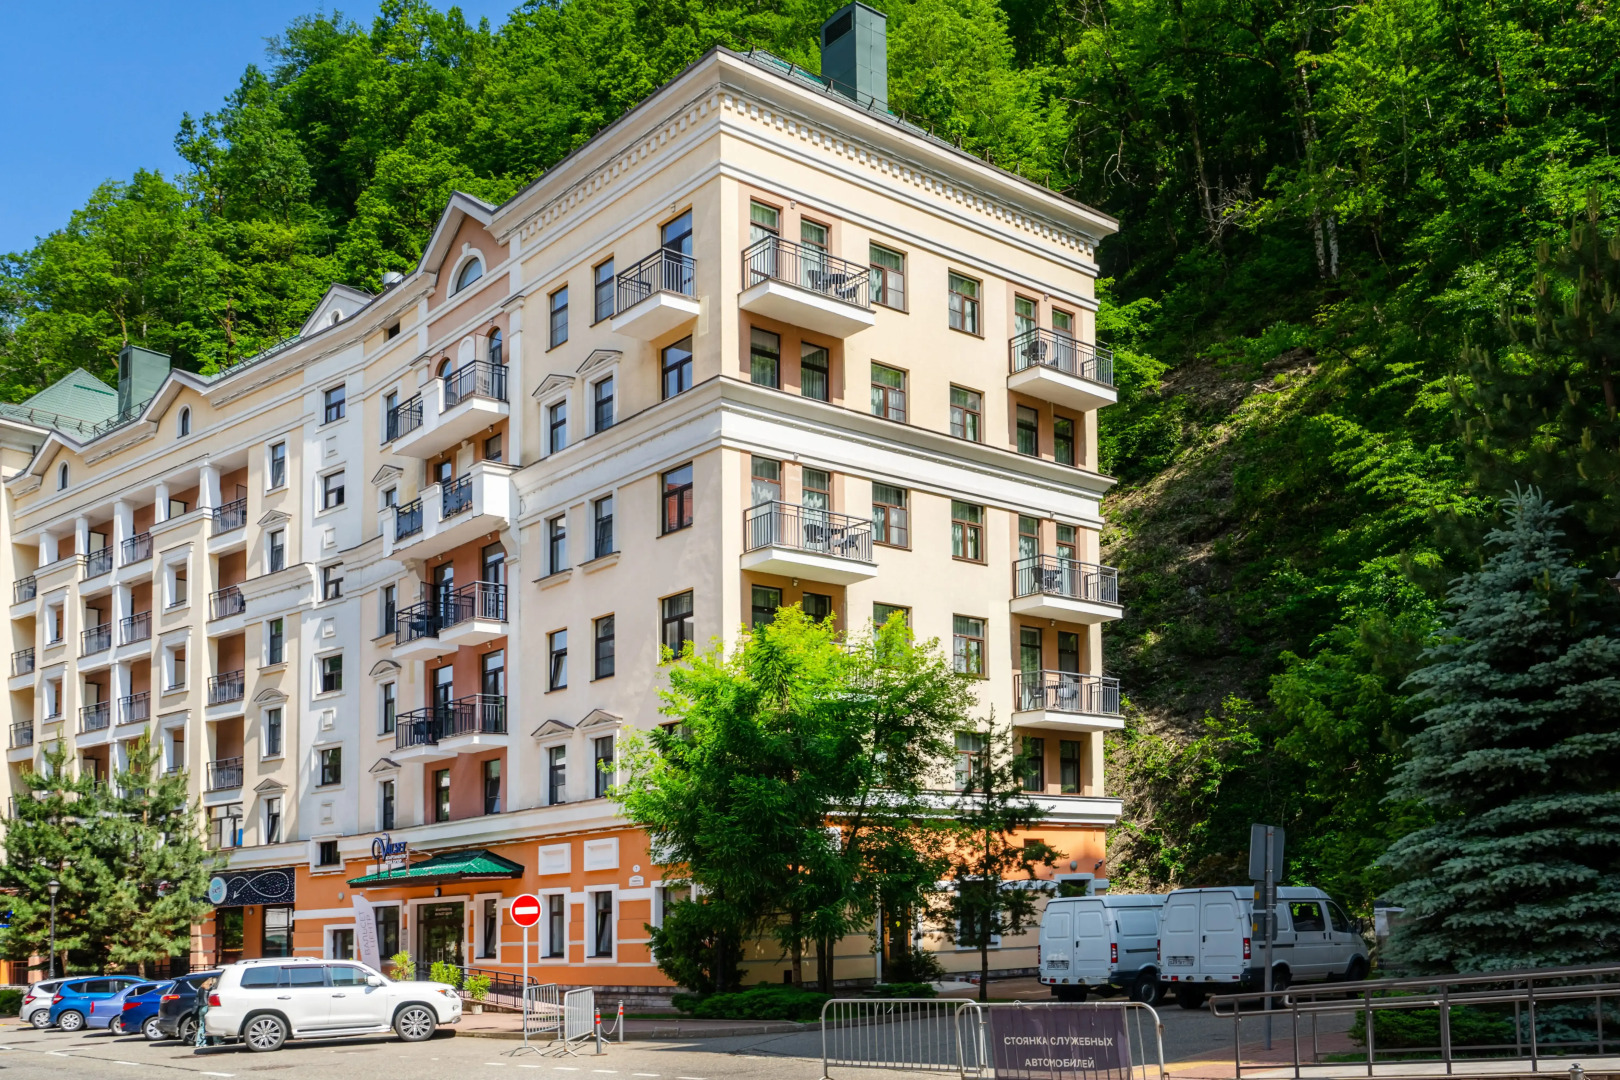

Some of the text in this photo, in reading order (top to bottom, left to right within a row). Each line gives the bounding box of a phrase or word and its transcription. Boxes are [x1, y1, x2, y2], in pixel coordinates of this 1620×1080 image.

[1003, 1036, 1113, 1047] СТОЯНКА СЛУЖЕБНЫХ
[1024, 1057, 1095, 1069] АВТОМОБИЛЕЙ
